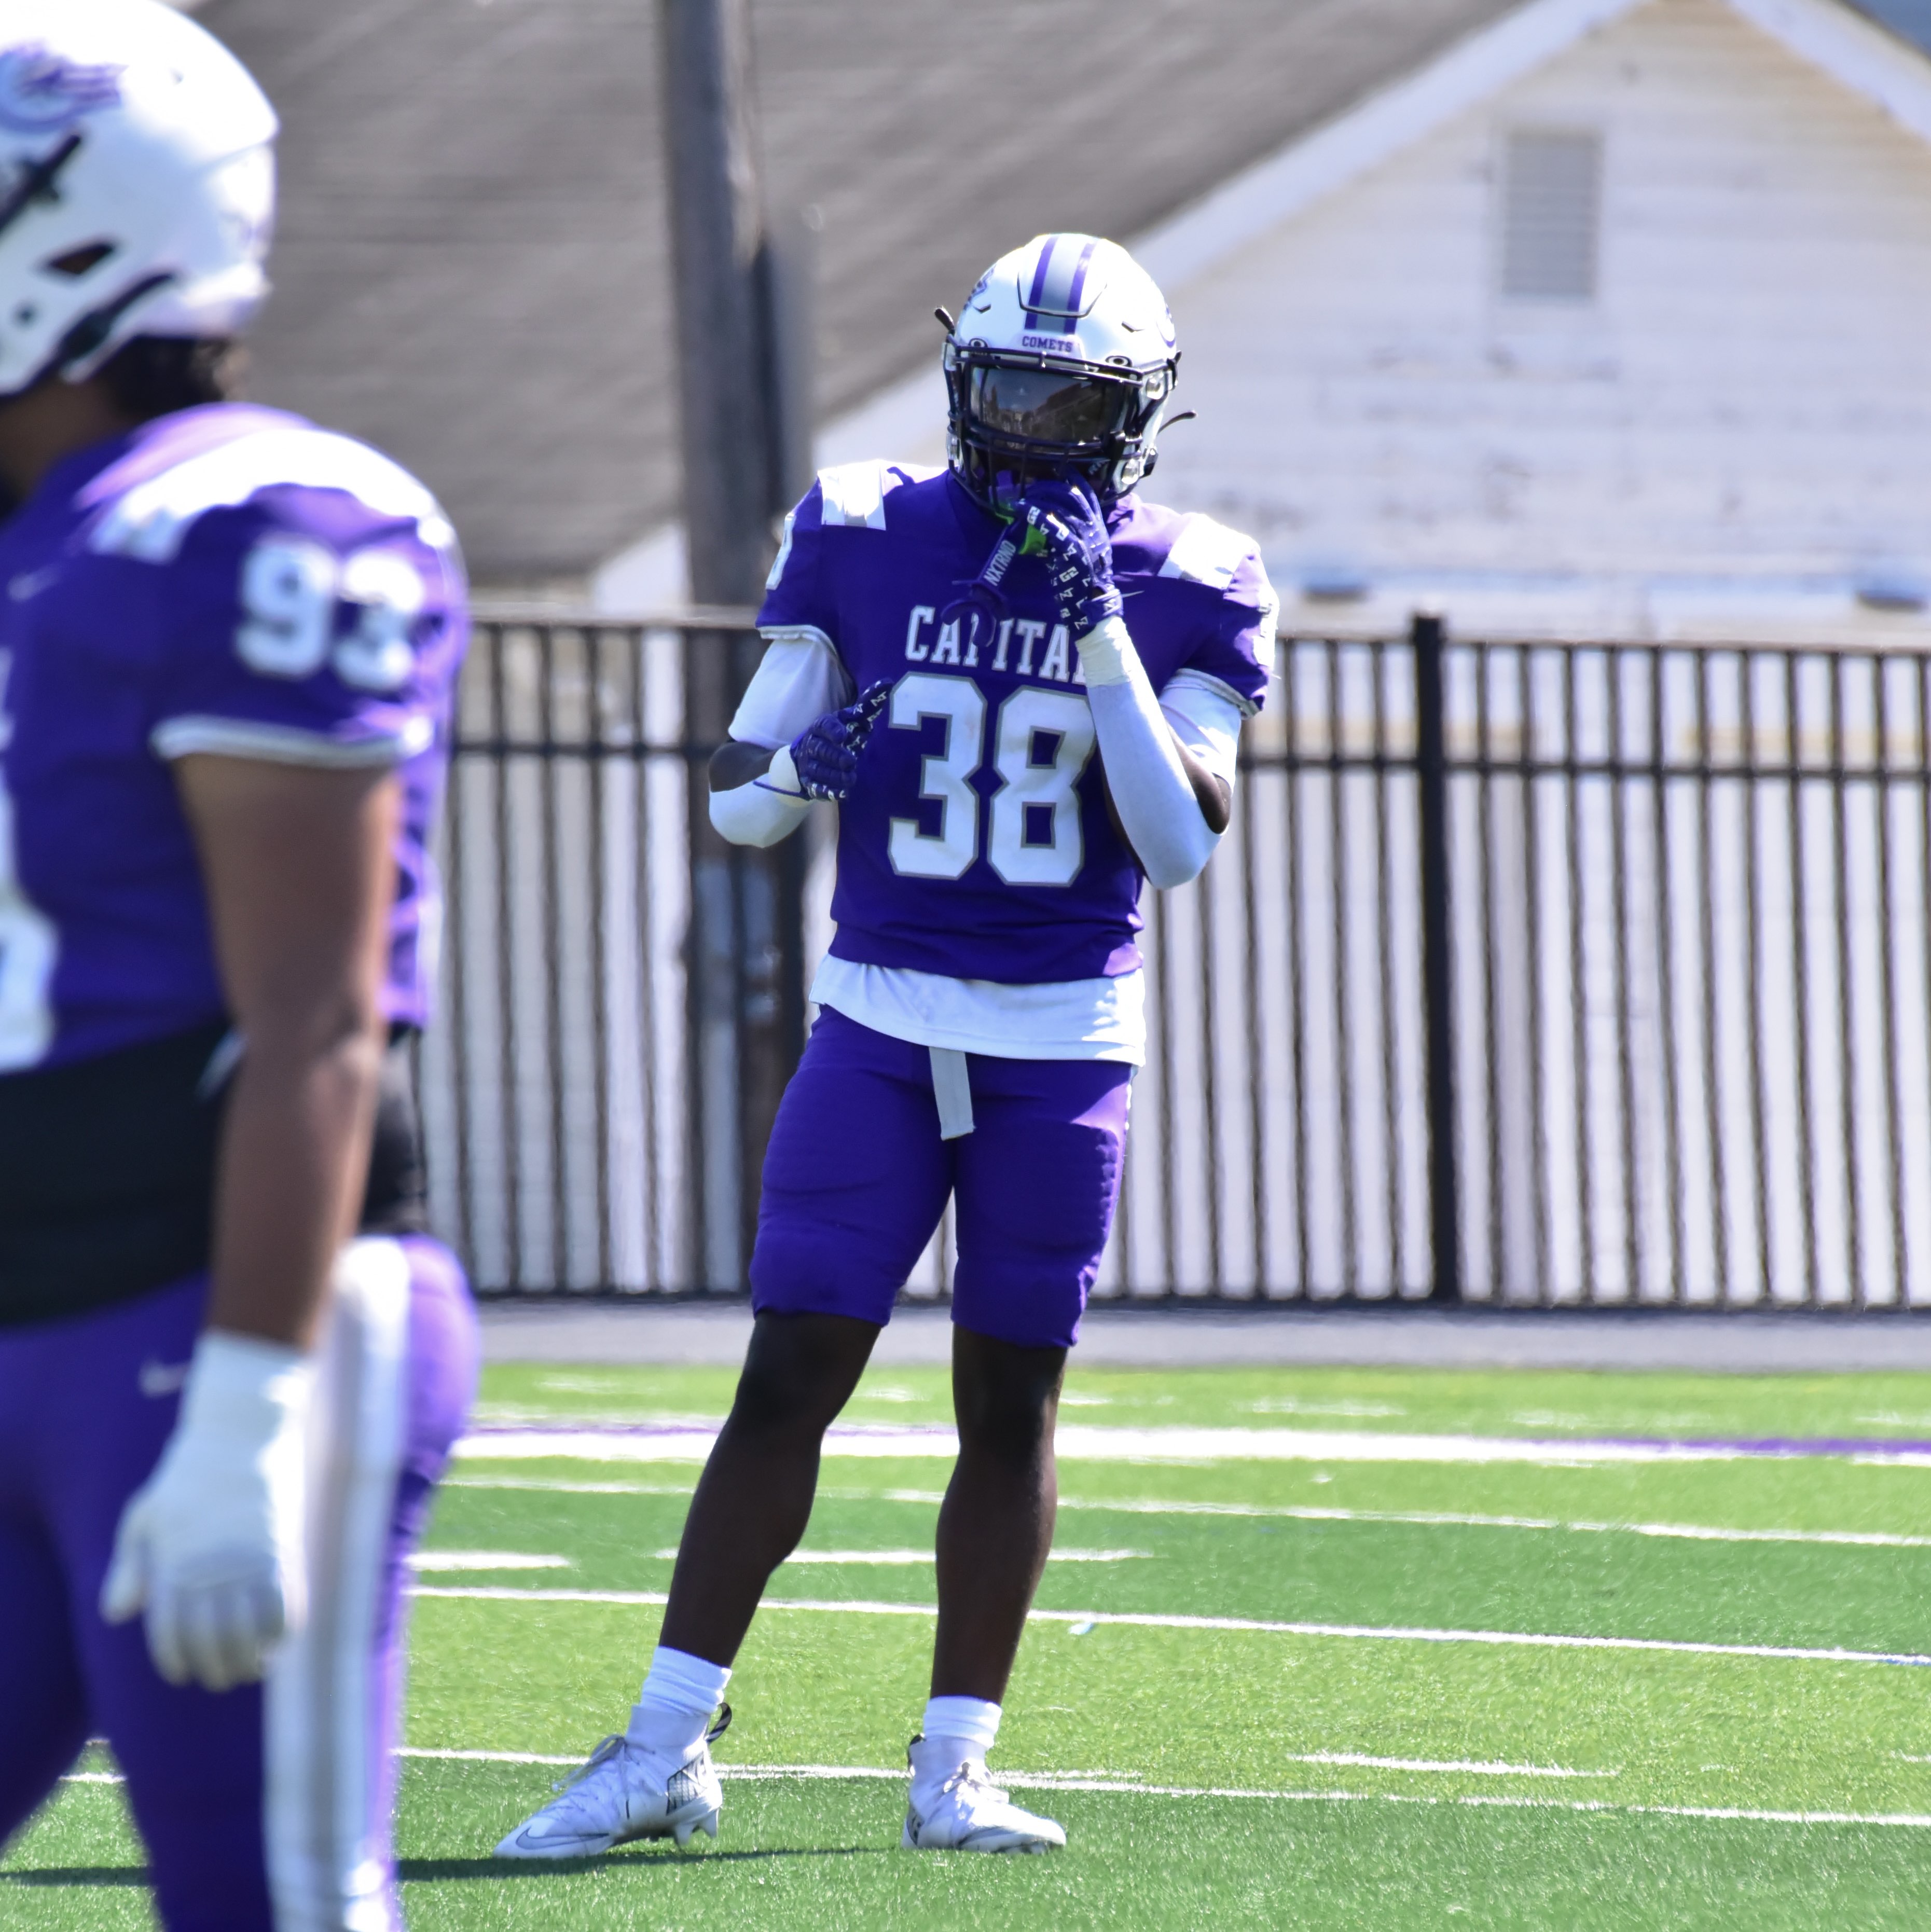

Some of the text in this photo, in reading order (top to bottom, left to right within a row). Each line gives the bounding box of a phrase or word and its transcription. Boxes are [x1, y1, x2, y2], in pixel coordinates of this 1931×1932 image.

[1022, 336, 1073, 353] COMETS
[236, 534, 424, 693] 93
[984, 540, 1016, 586] NXTRND
[888, 671, 1096, 888] 38
